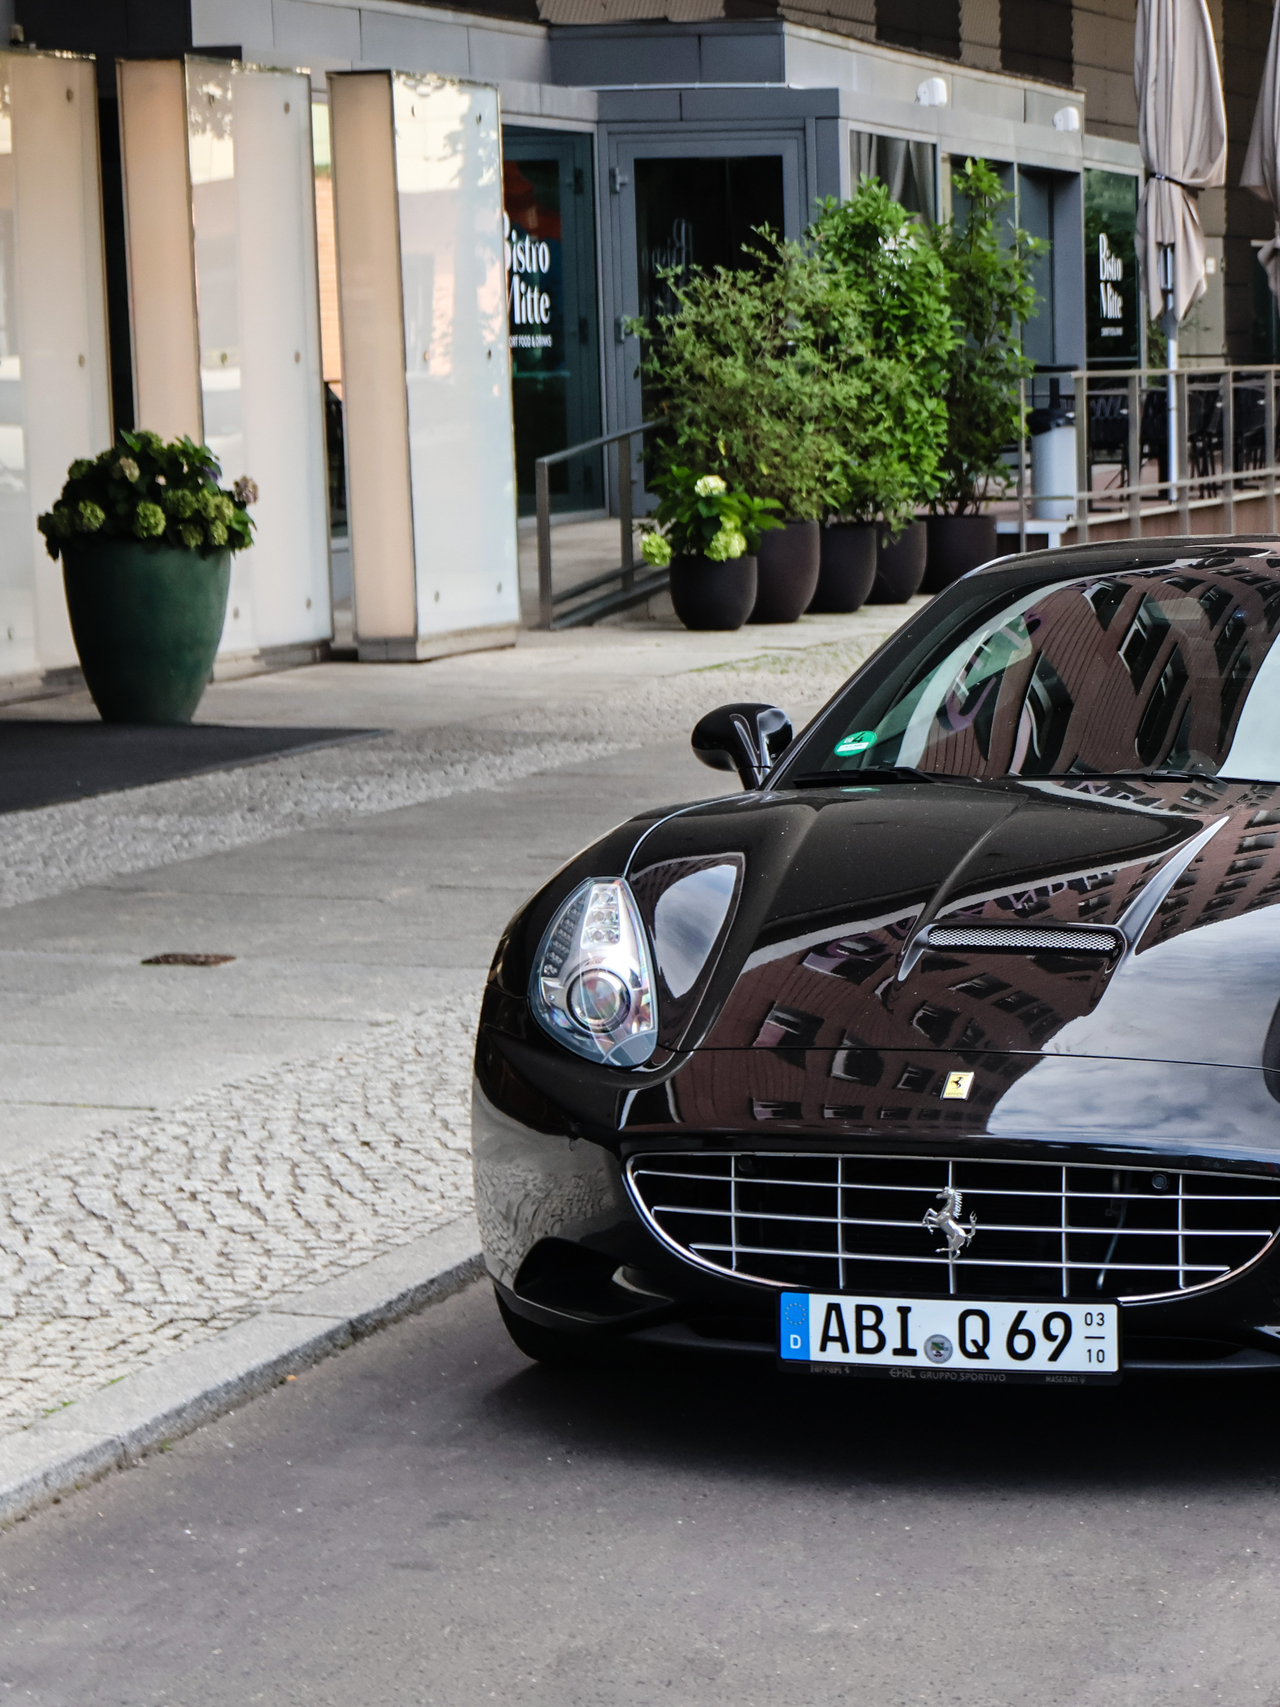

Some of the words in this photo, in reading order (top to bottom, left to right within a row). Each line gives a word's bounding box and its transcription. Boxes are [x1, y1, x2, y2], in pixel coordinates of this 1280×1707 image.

[1084, 1311, 1105, 1327] 03
[819, 1302, 918, 1357] ABI
[957, 1308, 990, 1360] Q
[1005, 1310, 1073, 1362] 69
[789, 1334, 801, 1349] D
[1086, 1348, 1105, 1364] 10
[919, 1370, 958, 1380] GRUPPO
[959, 1371, 1007, 1382] SPORTIVO
